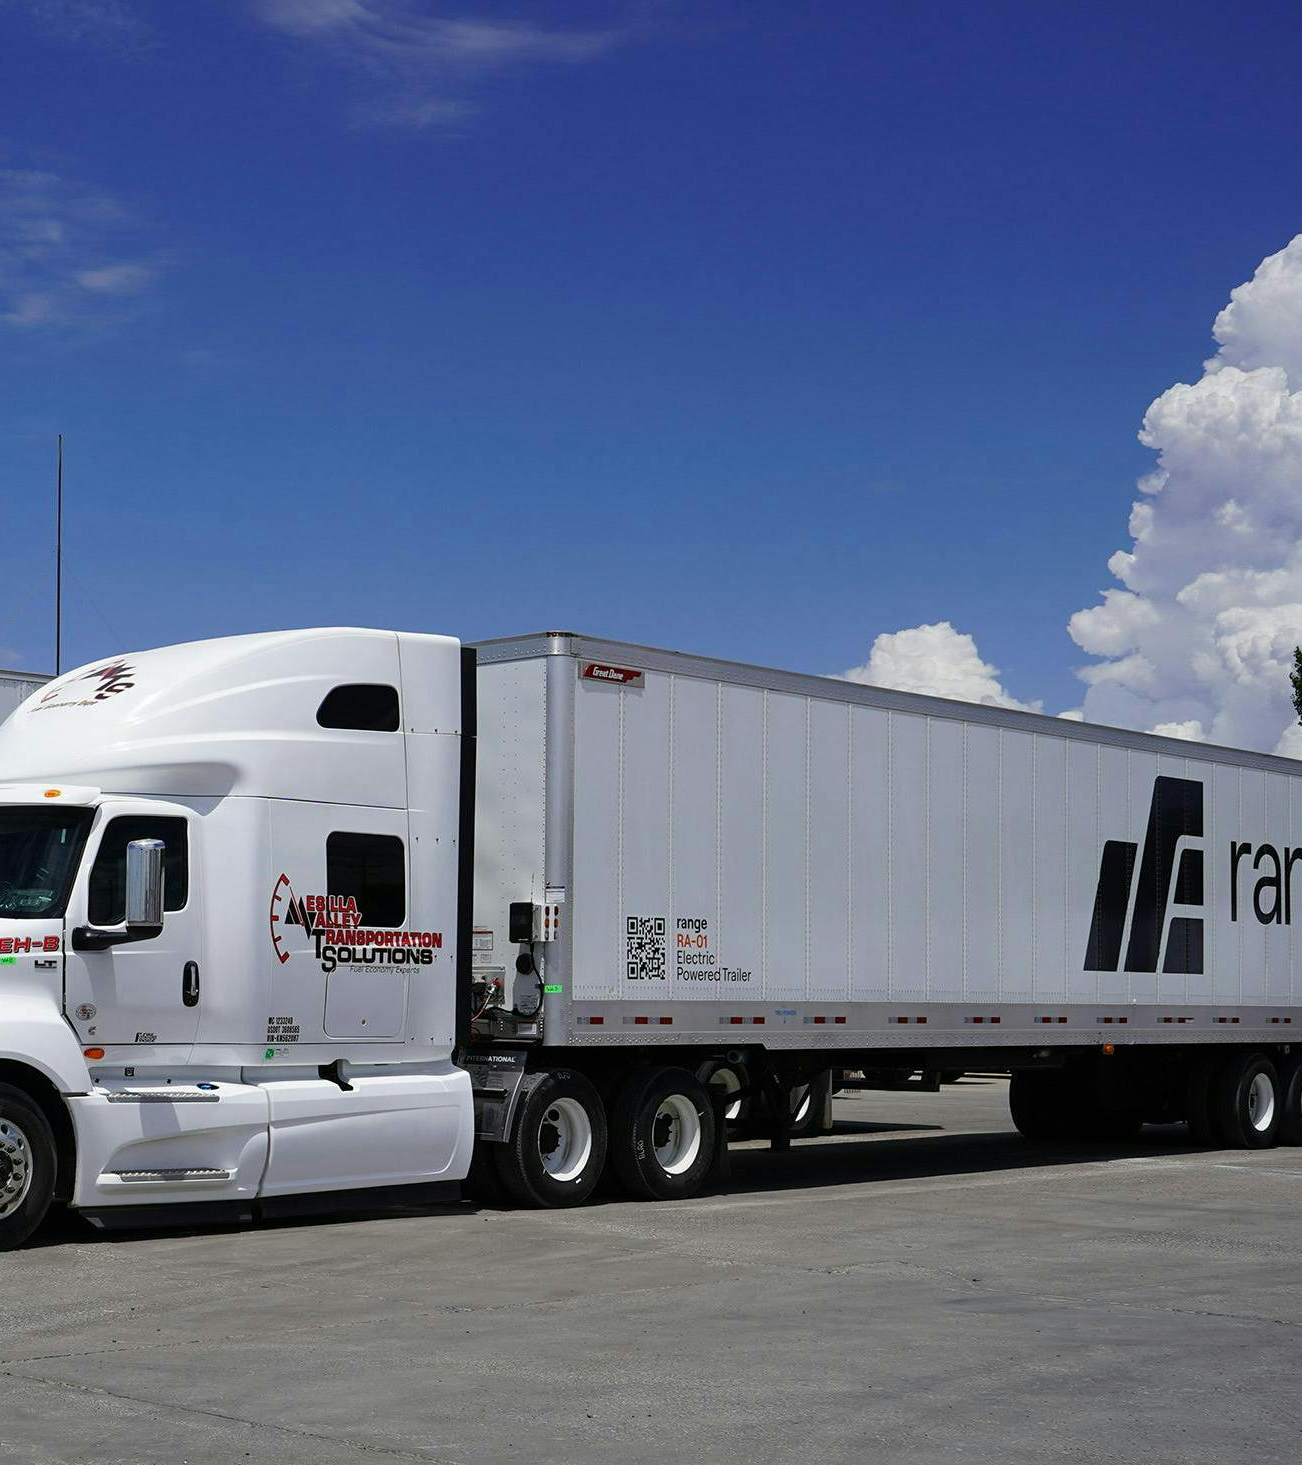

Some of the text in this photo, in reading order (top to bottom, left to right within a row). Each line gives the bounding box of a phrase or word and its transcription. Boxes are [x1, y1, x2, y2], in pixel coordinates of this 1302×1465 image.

[592, 666, 624, 680] Great Dane
[676, 918, 708, 933] range
[310, 929, 443, 958] TRANSPORTATION
[676, 934, 708, 949] RA-01
[322, 945, 434, 973] SOLUTIONS
[676, 950, 715, 965] Electric
[349, 965, 364, 973] Fuel
[676, 966, 752, 982] Powered Trailer
[268, 1016, 275, 1025] MC
[466, 1055, 516, 1063] INTERNATIONAL
